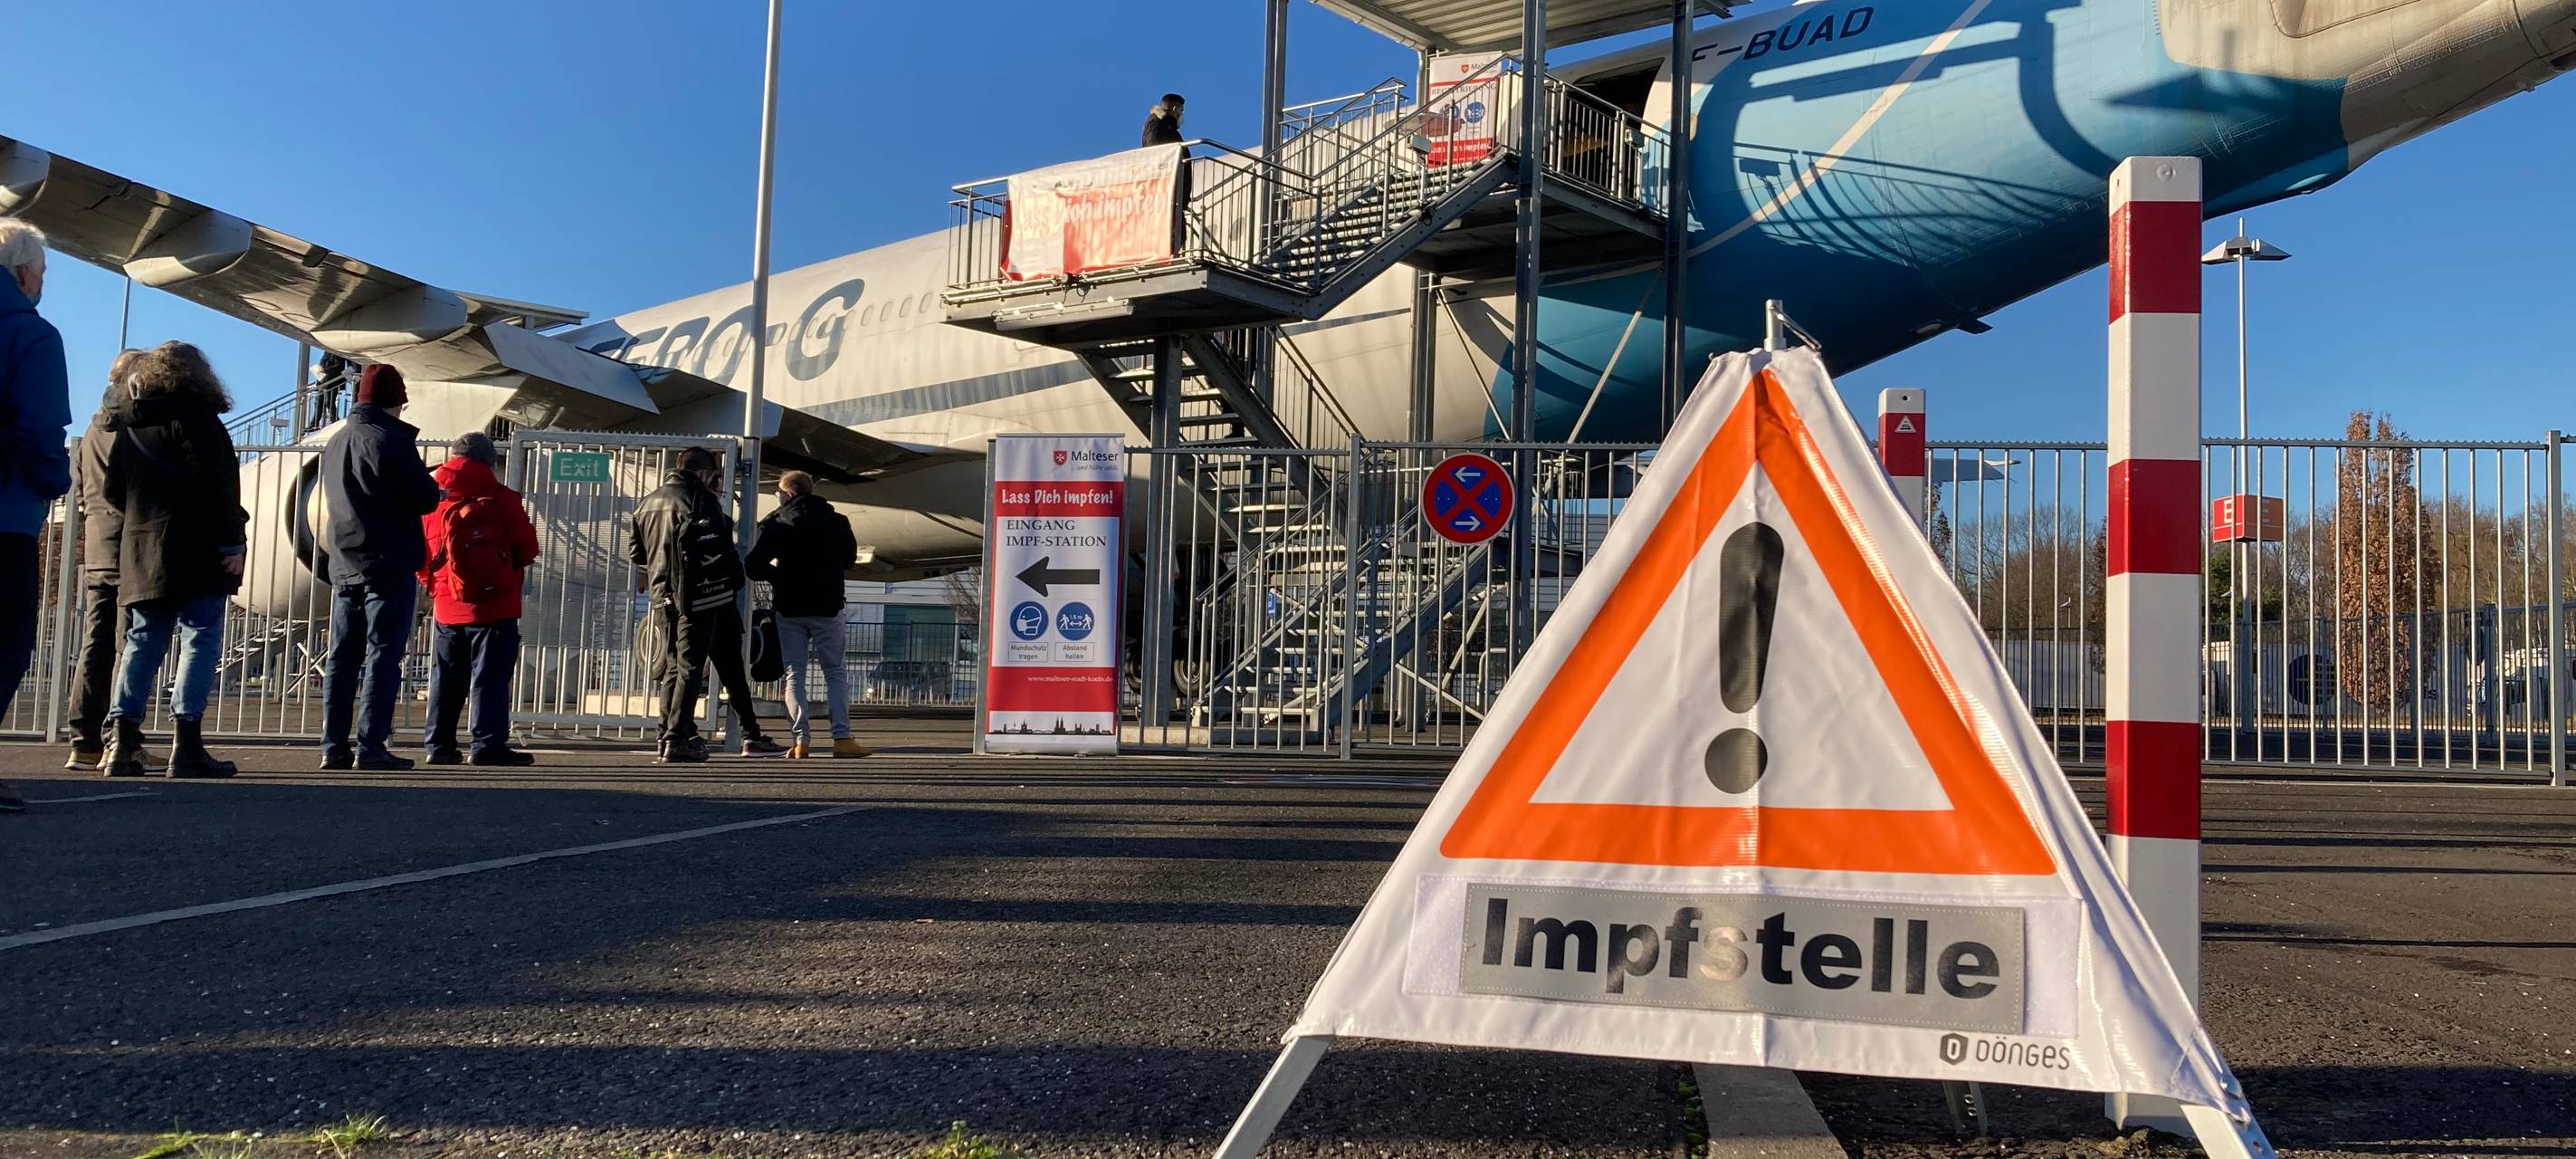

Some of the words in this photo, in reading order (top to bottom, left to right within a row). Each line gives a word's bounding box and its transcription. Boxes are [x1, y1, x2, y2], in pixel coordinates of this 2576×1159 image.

[1071, 450, 1119, 461] Malteser
[559, 457, 600, 477] Exit
[1001, 489, 1030, 503] Lass
[1034, 489, 1061, 503] Dich
[1064, 489, 1113, 507] impfen!
[1007, 519, 1075, 531] EINGANG
[1007, 535, 1107, 547] IMPF-STATION
[1018, 653, 1038, 661] tragen
[1481, 897, 2001, 1000] Impfstelle
